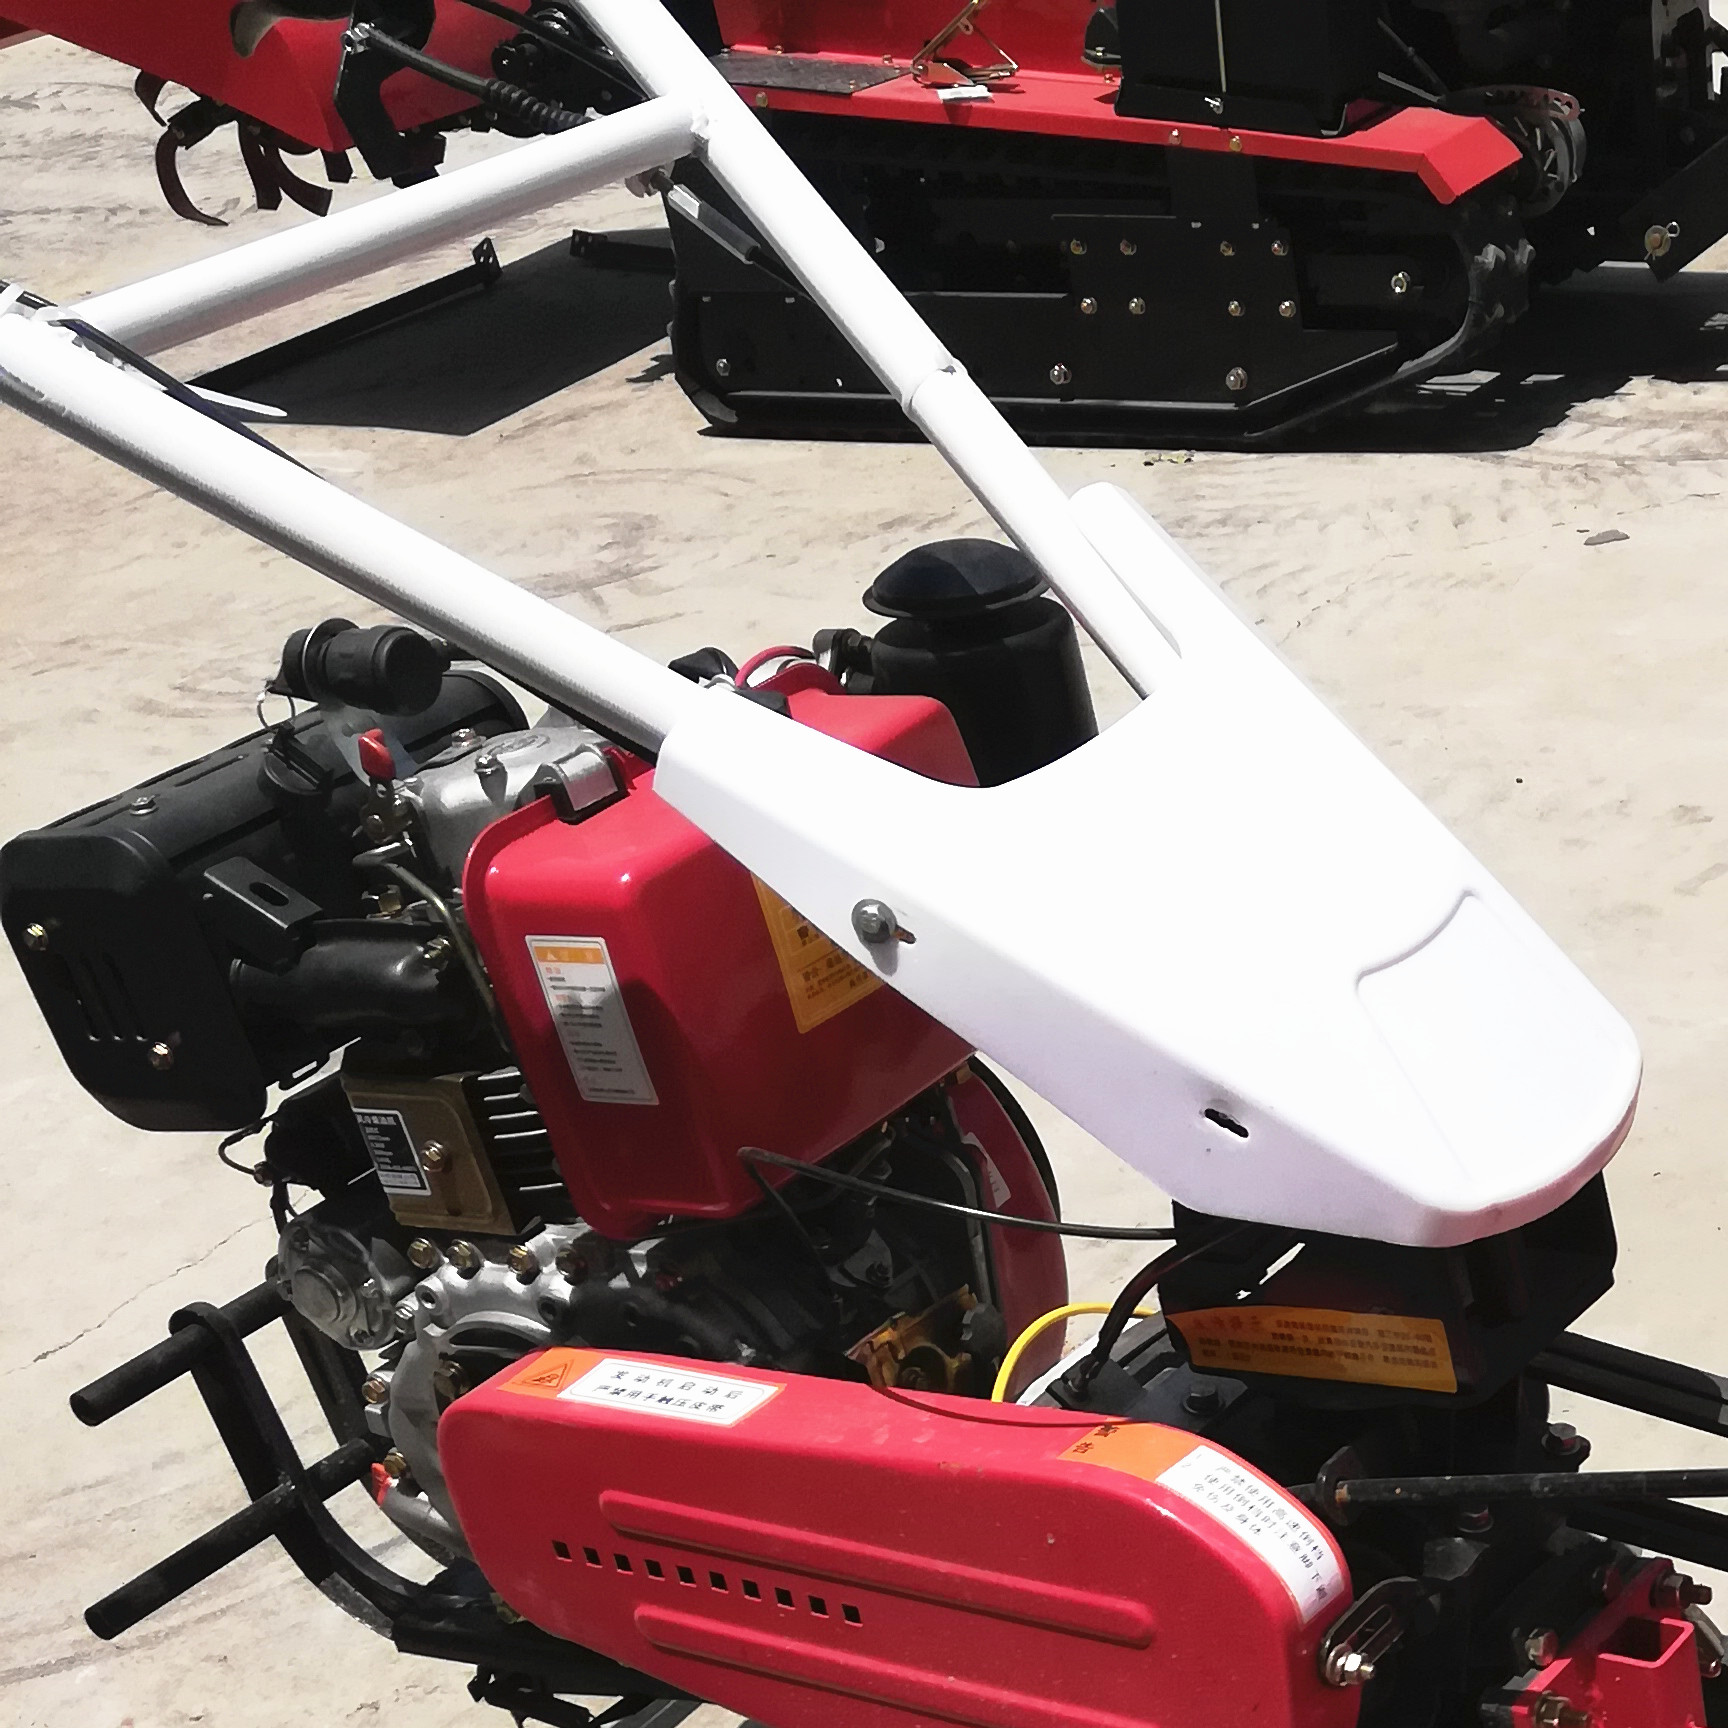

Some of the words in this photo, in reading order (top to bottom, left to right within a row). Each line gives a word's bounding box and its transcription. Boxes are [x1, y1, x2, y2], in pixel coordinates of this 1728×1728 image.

[611, 1370, 743, 1399] 发动机启动后
